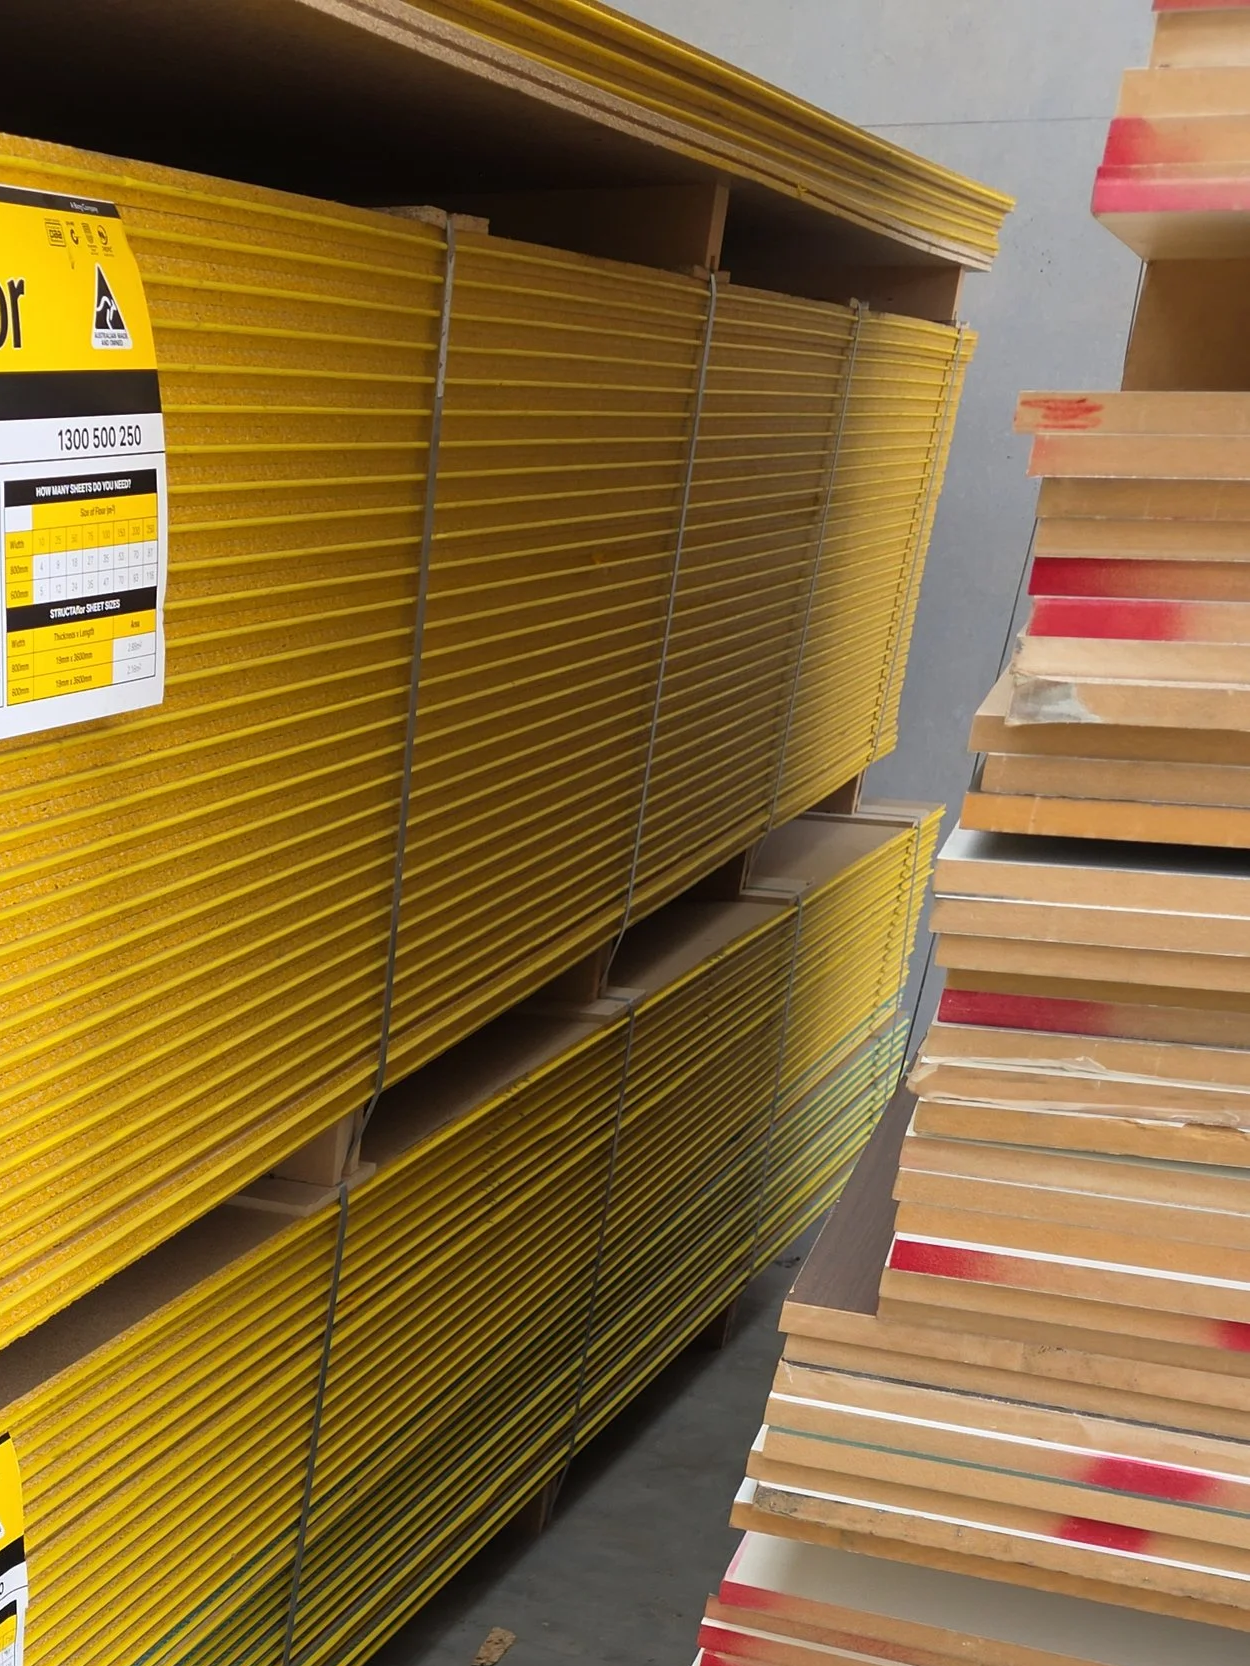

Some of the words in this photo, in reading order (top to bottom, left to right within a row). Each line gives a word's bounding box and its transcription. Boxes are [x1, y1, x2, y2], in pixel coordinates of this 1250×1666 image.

[58, 428, 89, 450] 1300
[93, 426, 116, 448] 500
[119, 425, 142, 446] 250
[36, 485, 52, 497] HOW
[52, 484, 70, 496] MANY
[70, 482, 92, 494] SHEETS
[92, 482, 102, 492] DO
[102, 480, 114, 491] YOU
[114, 479, 132, 490] NEED?
[86, 602, 104, 614] SHEET
[105, 600, 121, 610] SIZES
